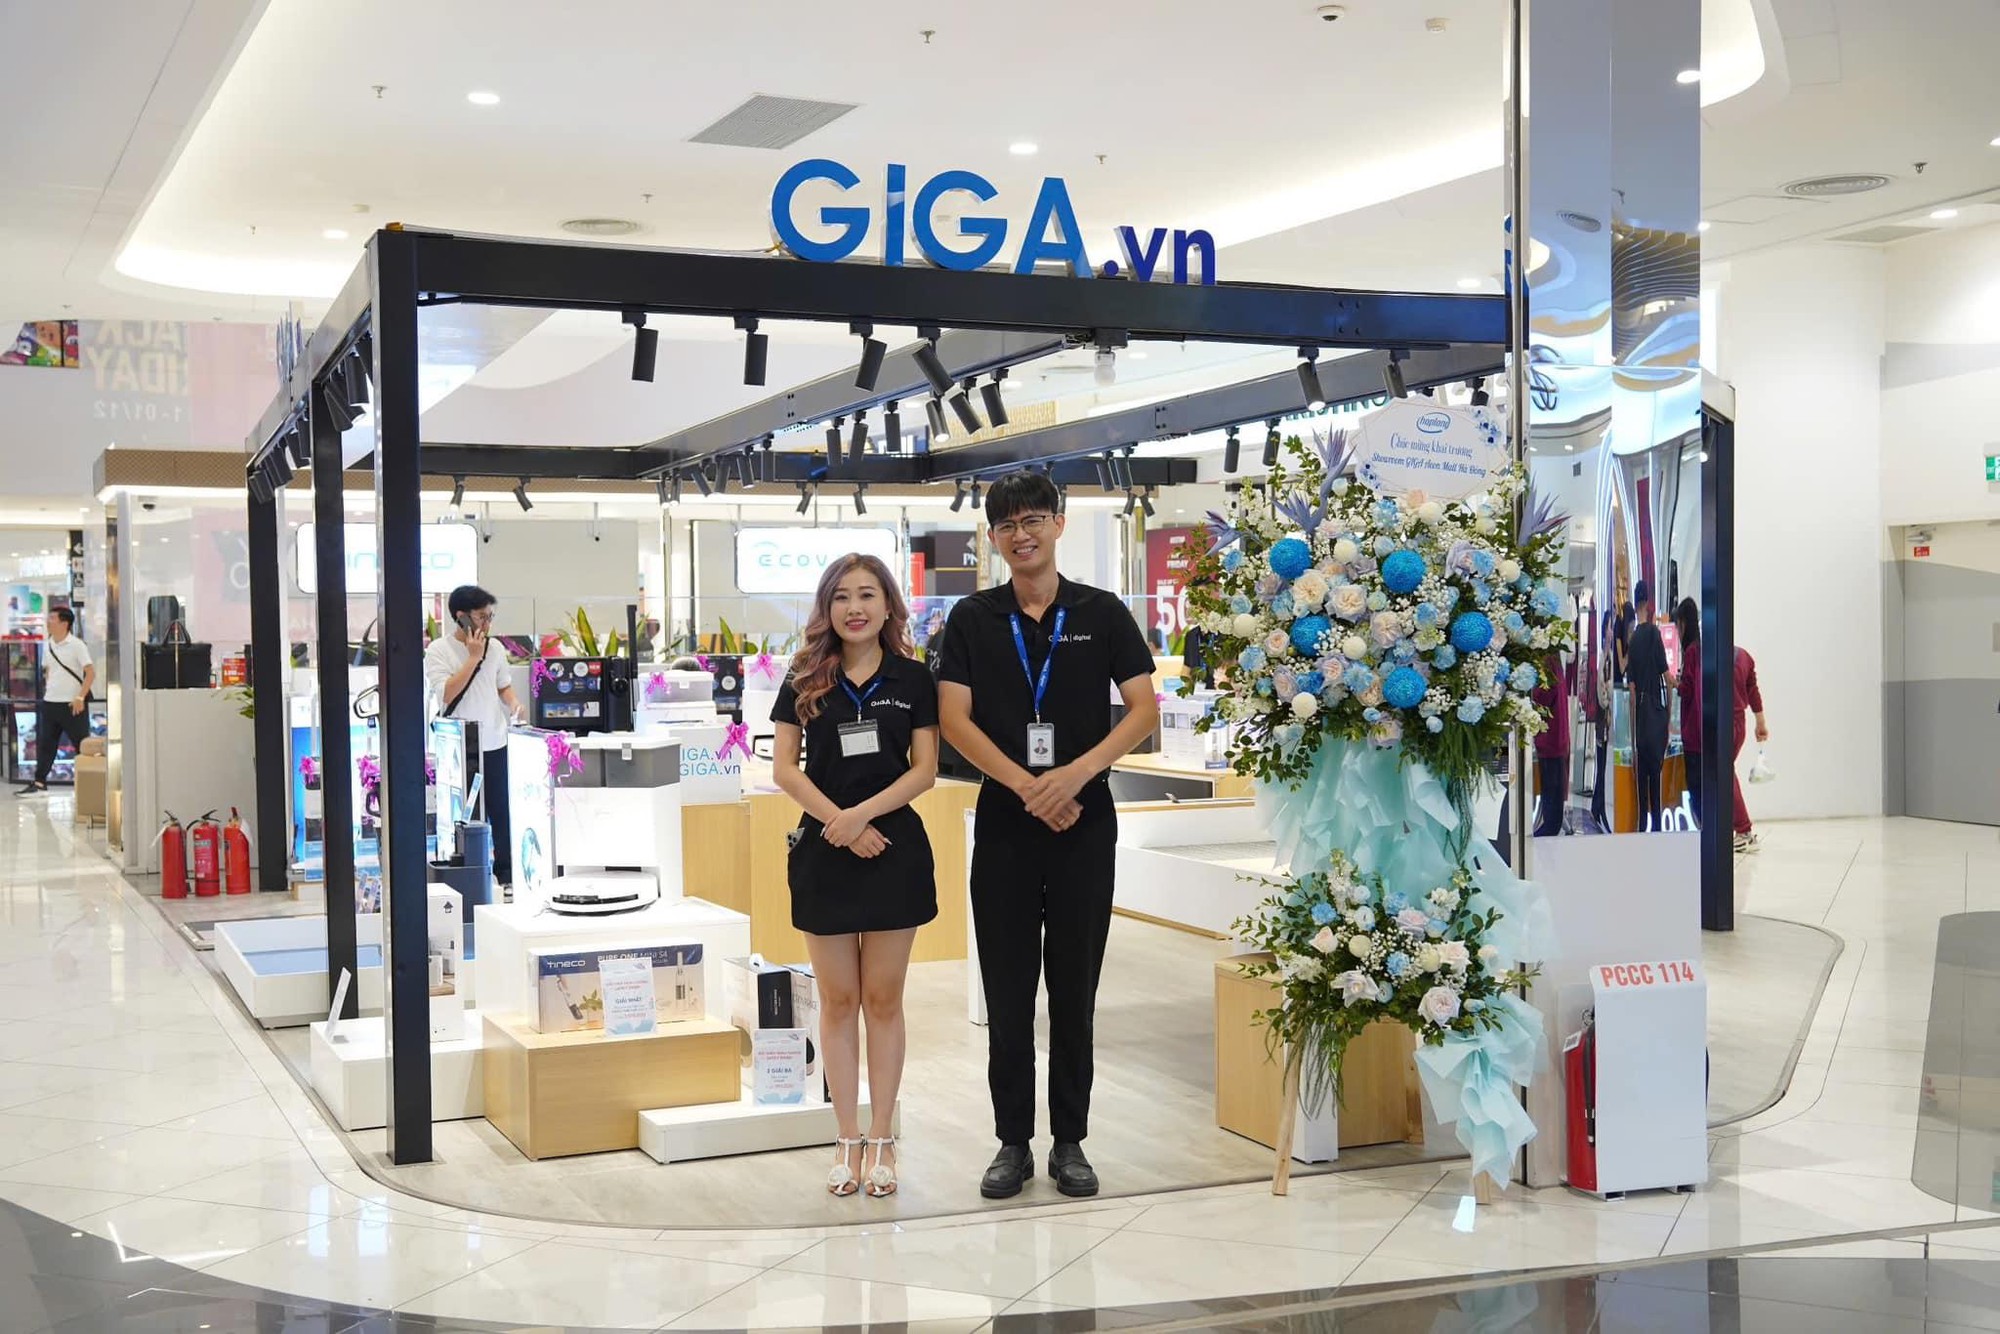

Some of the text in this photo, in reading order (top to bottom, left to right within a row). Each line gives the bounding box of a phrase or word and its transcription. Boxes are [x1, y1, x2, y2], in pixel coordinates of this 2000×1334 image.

[771, 158, 1216, 286] GIGA.vn
[758, 554, 829, 567] ECOV
[1600, 962, 1694, 987] PCCC 114
